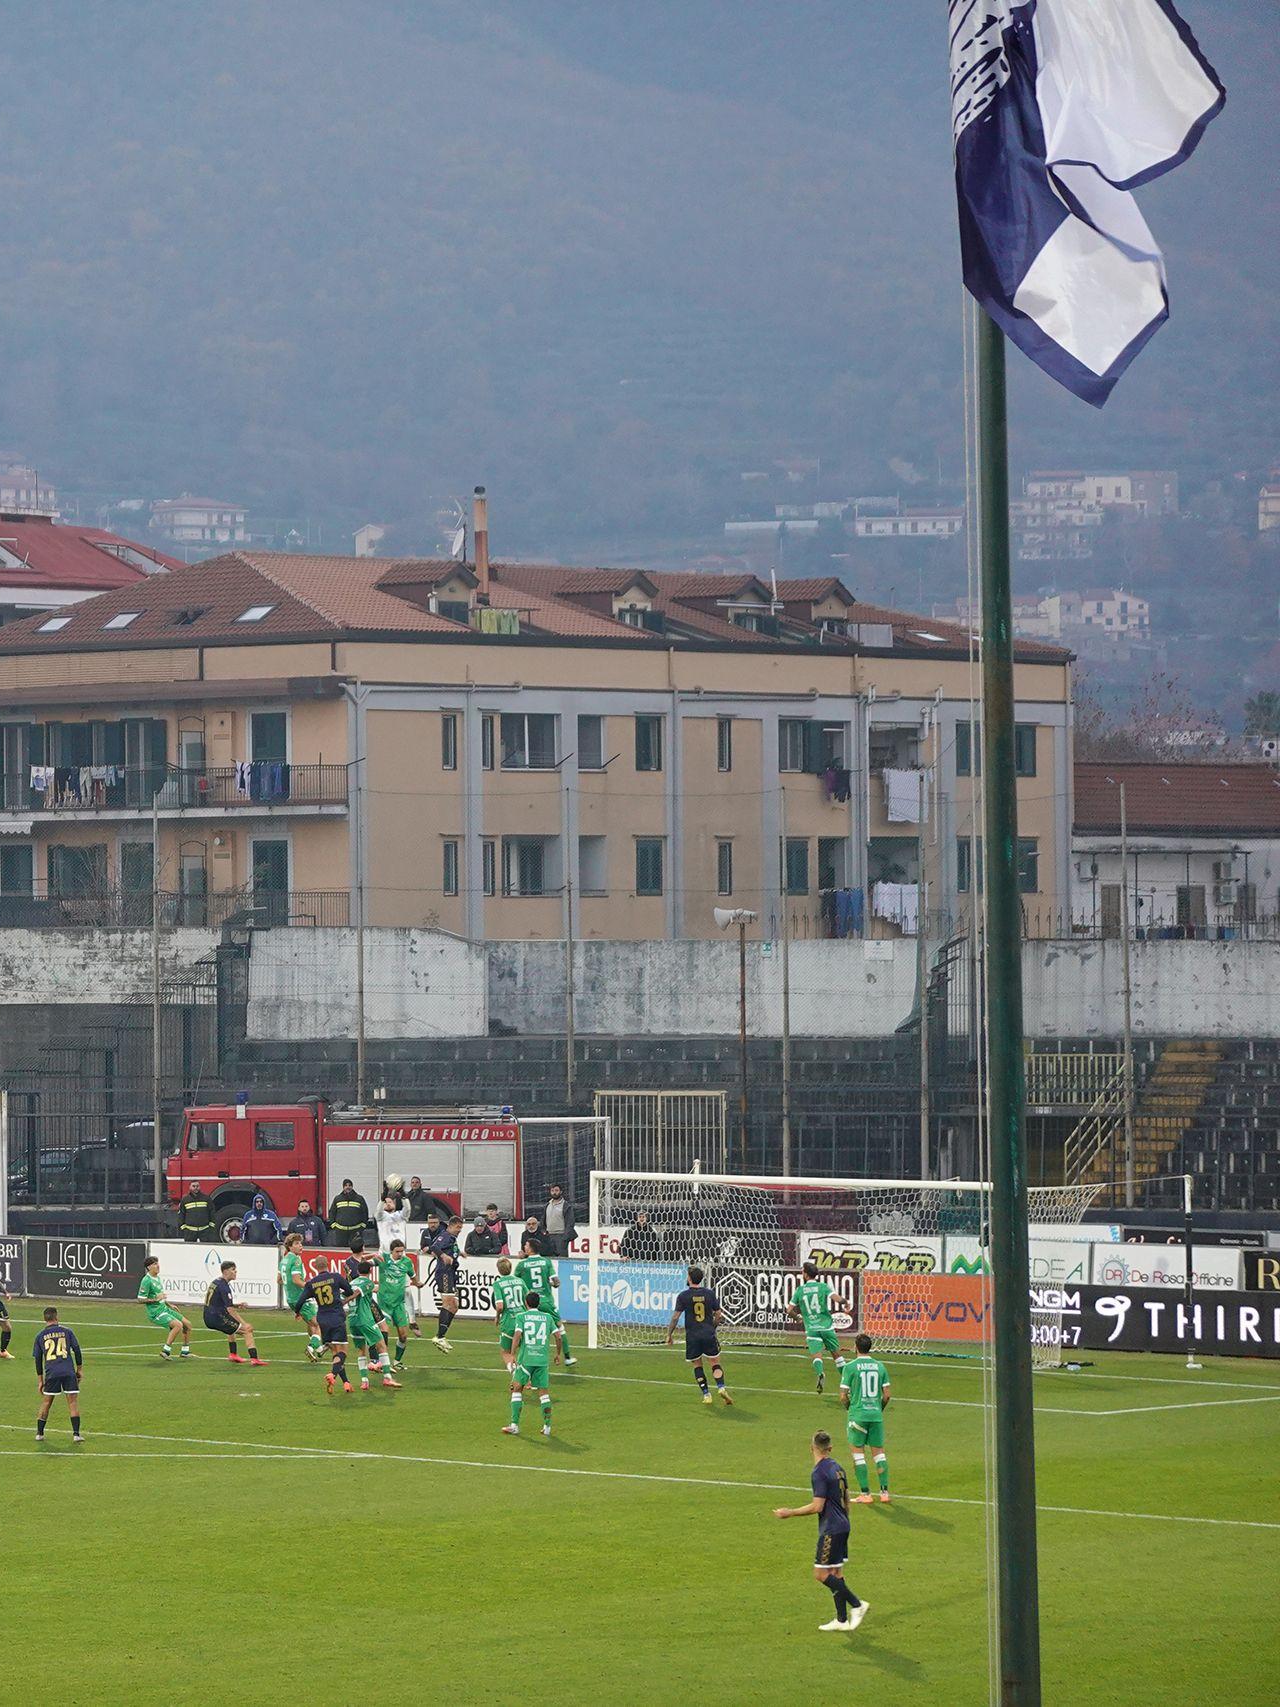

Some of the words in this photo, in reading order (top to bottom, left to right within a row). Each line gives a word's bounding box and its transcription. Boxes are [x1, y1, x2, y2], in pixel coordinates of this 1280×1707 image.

[356, 1128, 404, 1140] VIGILI
[410, 1128, 435, 1140] DEL
[441, 1128, 490, 1140] FUOCO
[46, 1242, 127, 1273] LIGUORI
[572, 1263, 619, 1274] INSTAAZIONE
[59, 1277, 81, 1288] caffè
[81, 1278, 114, 1290] italiano
[227, 1282, 272, 1295] NVITTO
[530, 1266, 543, 1289] 5
[1131, 1270, 1150, 1283] De
[1152, 1270, 1186, 1284] Rosa
[315, 1285, 334, 1306] 13
[458, 1287, 497, 1311] BIS
[503, 1286, 524, 1309] 20
[756, 1272, 854, 1312] GRONO
[803, 1293, 822, 1314] 14
[693, 1302, 706, 1322] 9
[893, 1299, 991, 1323] GIVOV
[523, 1321, 547, 1345] 24
[1143, 1302, 1280, 1344] THIR
[44, 1337, 69, 1361] 24
[860, 1371, 880, 1398] 10
